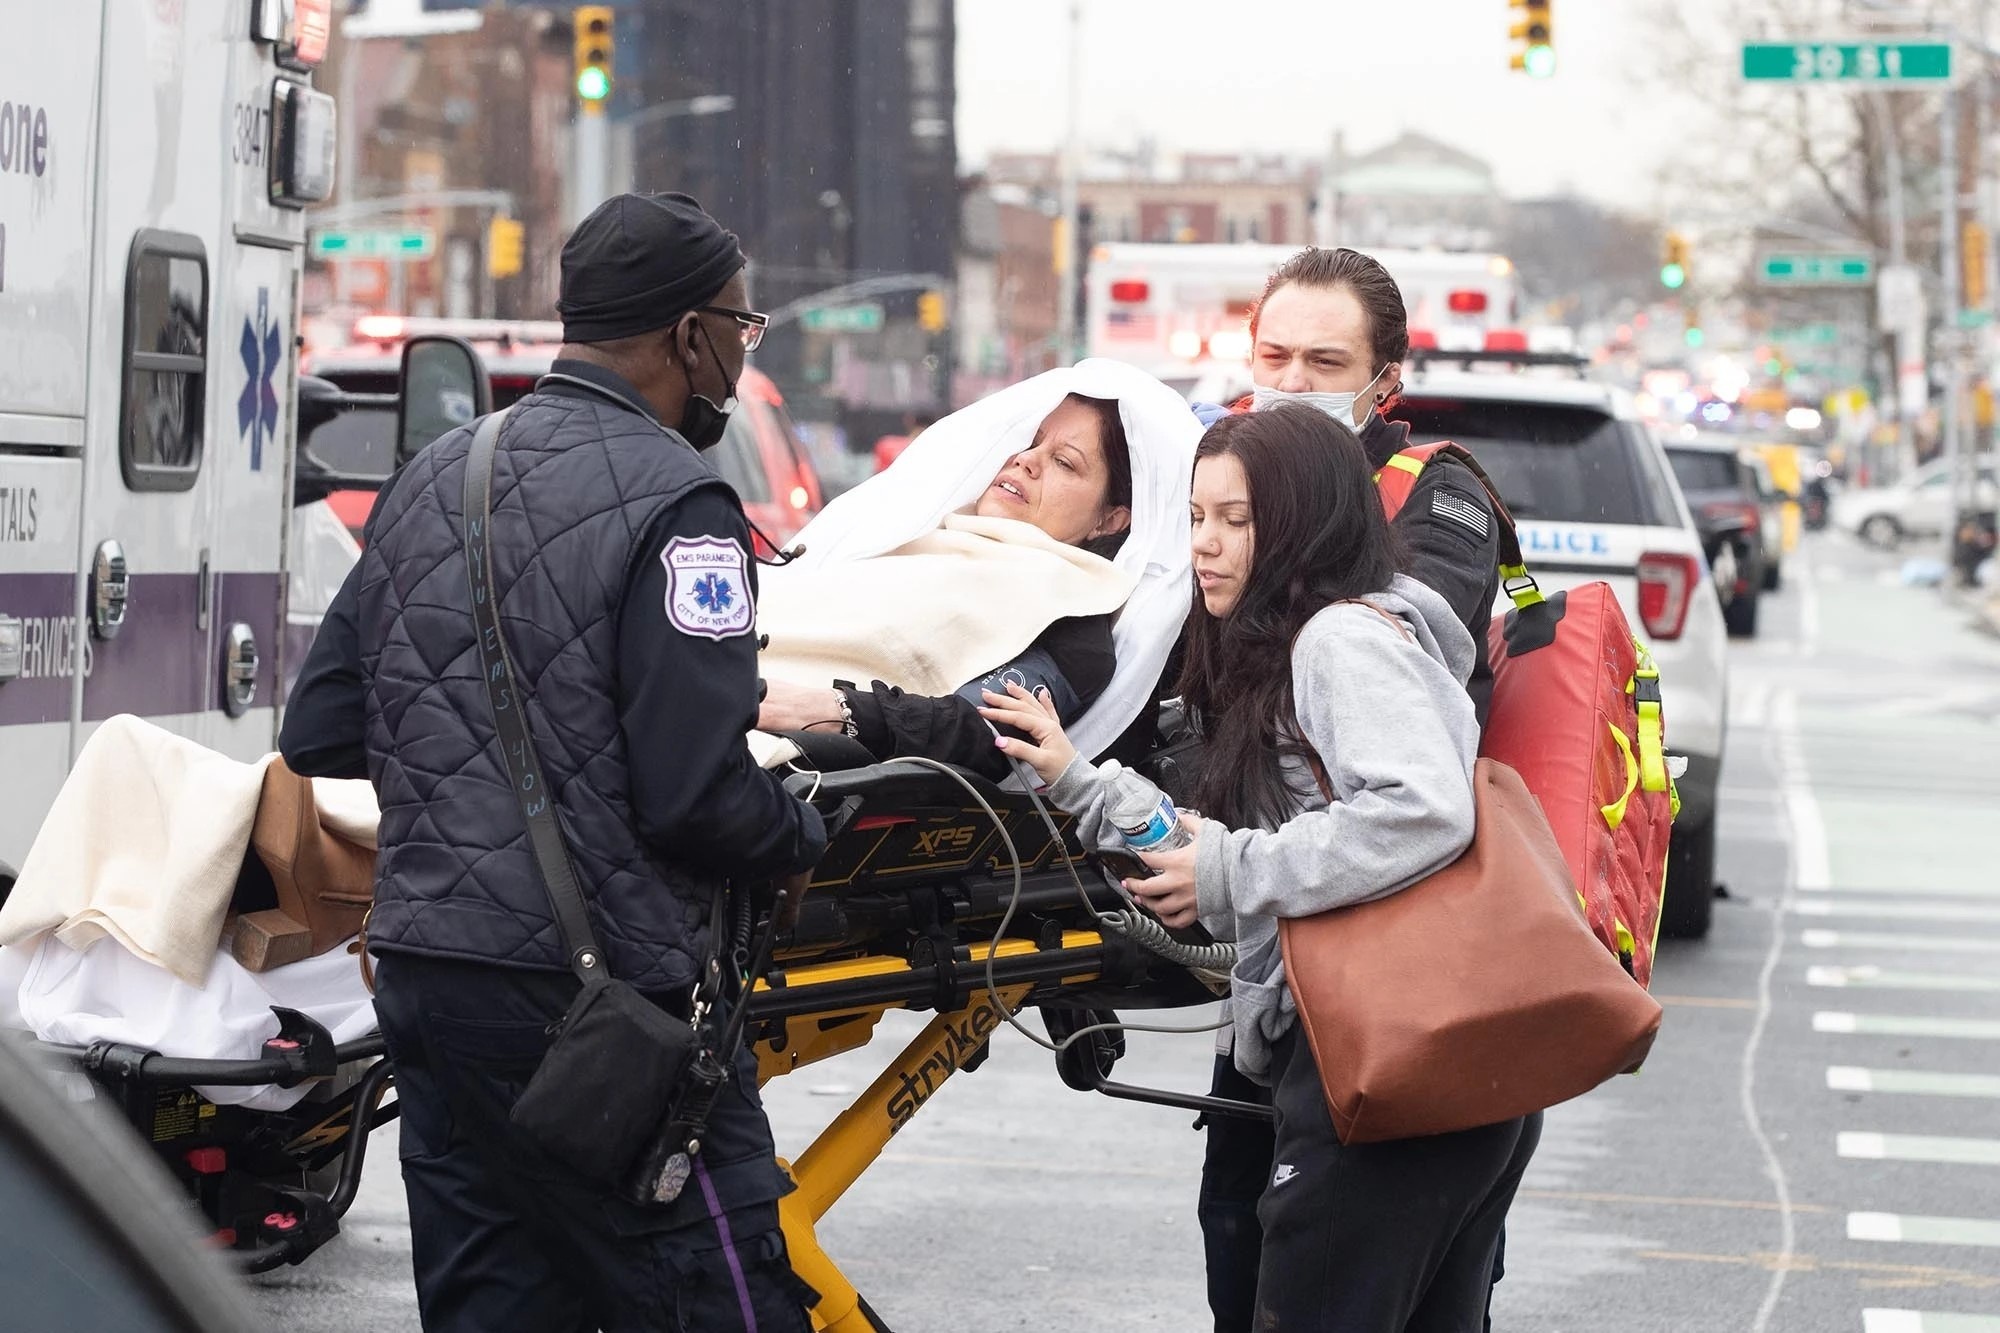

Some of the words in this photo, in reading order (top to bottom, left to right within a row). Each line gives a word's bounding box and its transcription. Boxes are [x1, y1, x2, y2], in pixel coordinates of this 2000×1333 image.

[0, 101, 47, 177] one
[232, 102, 269, 168] 3847
[0, 487, 37, 541] TALS
[469, 515, 485, 604] NYU
[676, 554, 695, 563] EMS
[696, 553, 737, 563] PARAMEDIC
[677, 603, 695, 619] CITY
[697, 615, 711, 625] OF
[712, 617, 730, 625] NEW
[732, 604, 747, 621] YORK
[17, 616, 93, 678] ERVICES
[912, 826, 976, 854] XPS
